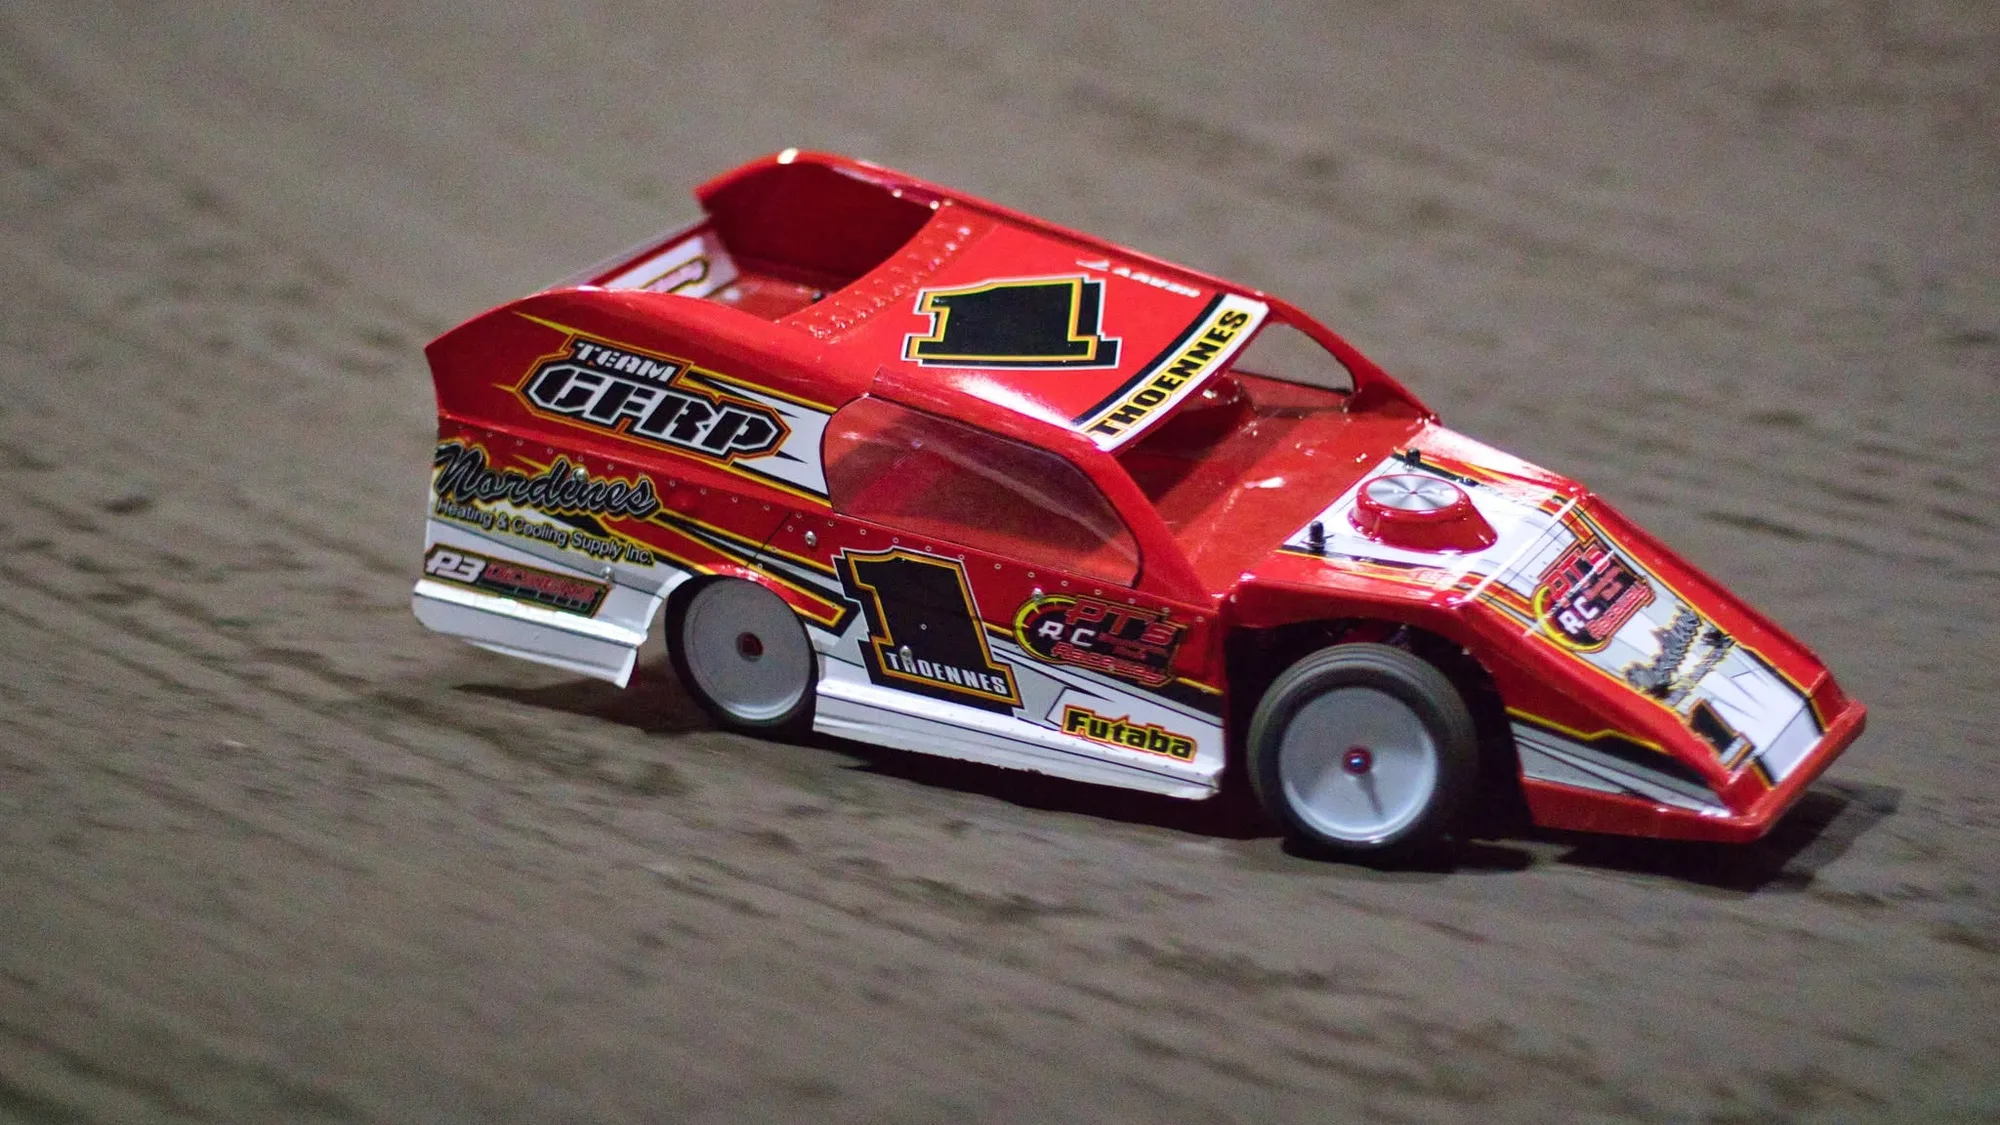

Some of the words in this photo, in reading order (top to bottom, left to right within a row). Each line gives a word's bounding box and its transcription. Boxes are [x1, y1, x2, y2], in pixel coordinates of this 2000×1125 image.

[902, 274, 1123, 370] 1
[573, 341, 678, 383] TEAM
[1090, 309, 1249, 438] THOENNES
[524, 364, 781, 456] GFRP
[434, 440, 659, 518] Nordines
[436, 501, 495, 529] Heating
[498, 513, 510, 530] &
[511, 516, 570, 547] Cooling
[571, 531, 623, 559] Supply
[624, 543, 655, 565] Inc.
[838, 547, 1022, 714] 1
[886, 652, 1010, 697] THOENNES
[1066, 711, 1195, 759] Futaba
